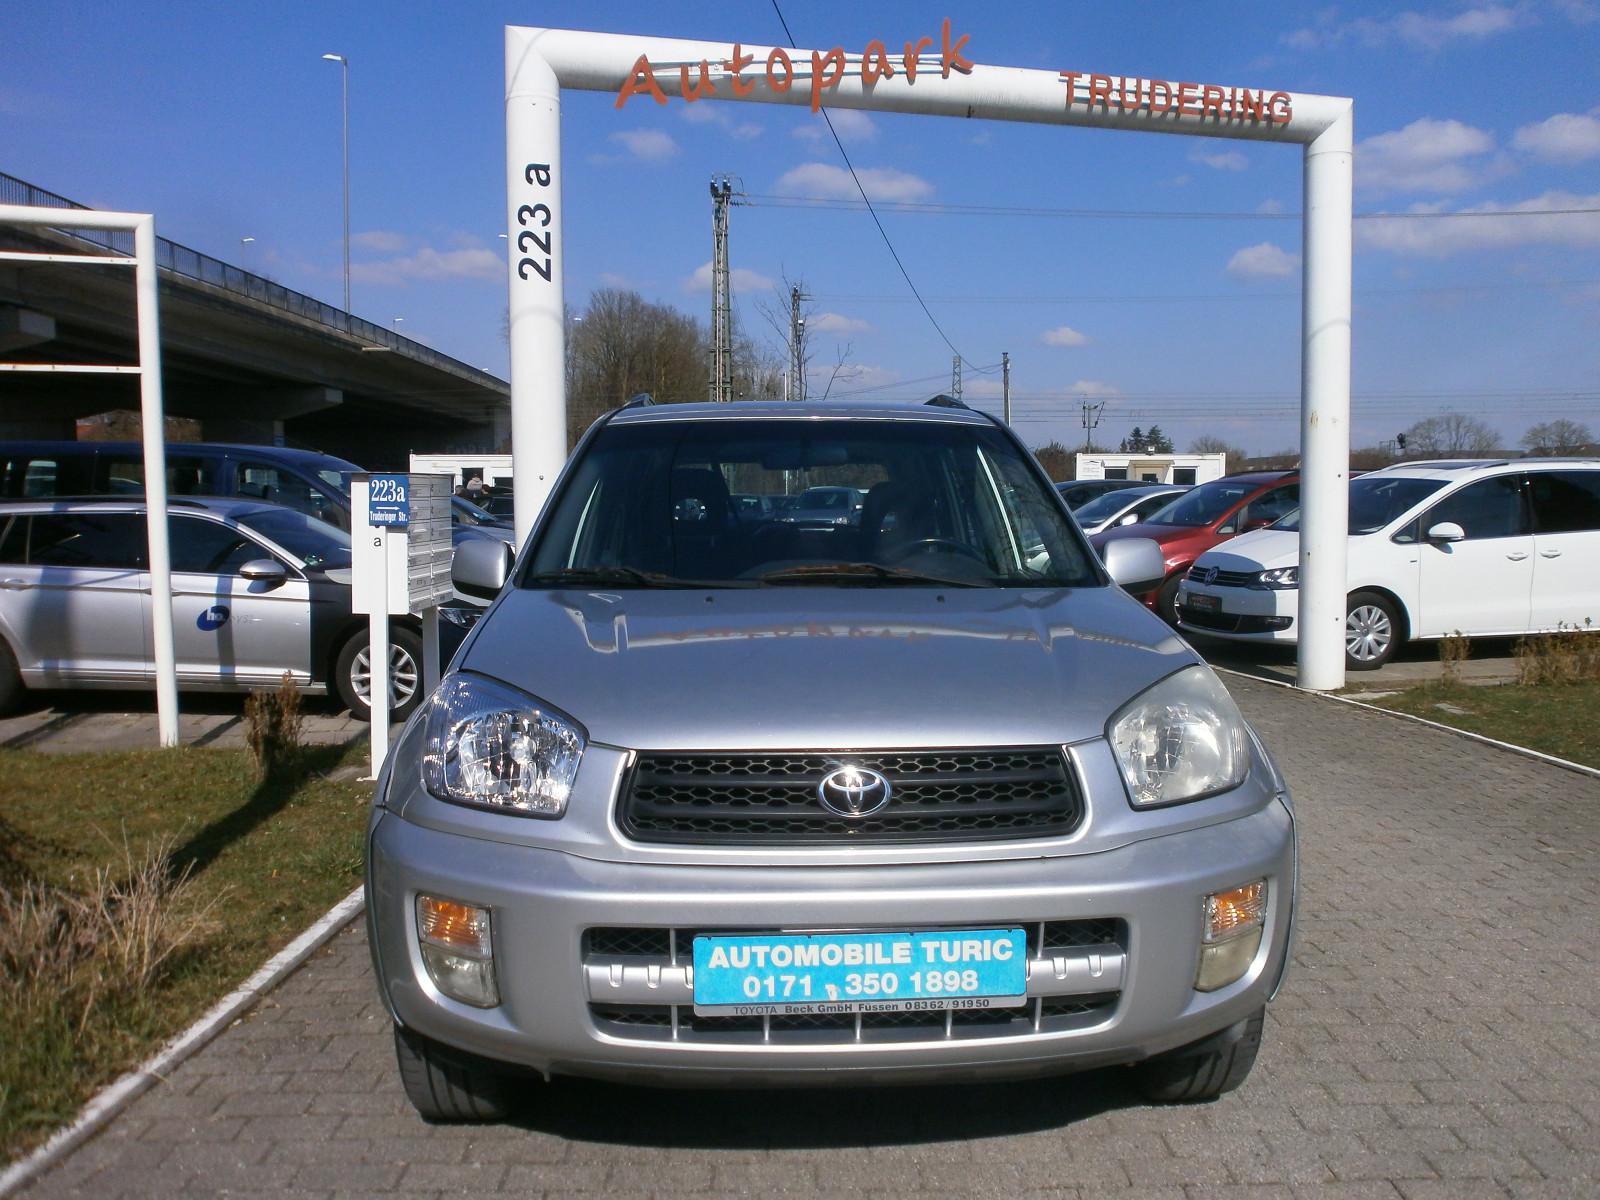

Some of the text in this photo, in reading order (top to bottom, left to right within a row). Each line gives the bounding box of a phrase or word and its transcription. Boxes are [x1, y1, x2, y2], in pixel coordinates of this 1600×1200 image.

[615, 17, 975, 113] Autopark
[1060, 71, 1293, 123] TRUDERING
[518, 163, 551, 282] 223 a
[371, 479, 406, 502] 223a
[369, 511, 408, 523] Truderinger Str.
[373, 537, 382, 547] a
[708, 939, 1014, 969] AUTOMOBILE TURIC
[743, 970, 979, 998] 0171 350 1898
[733, 1006, 778, 1015] TOYOTA
[785, 1004, 814, 1014] Beck
[817, 1003, 853, 1013] GmbH
